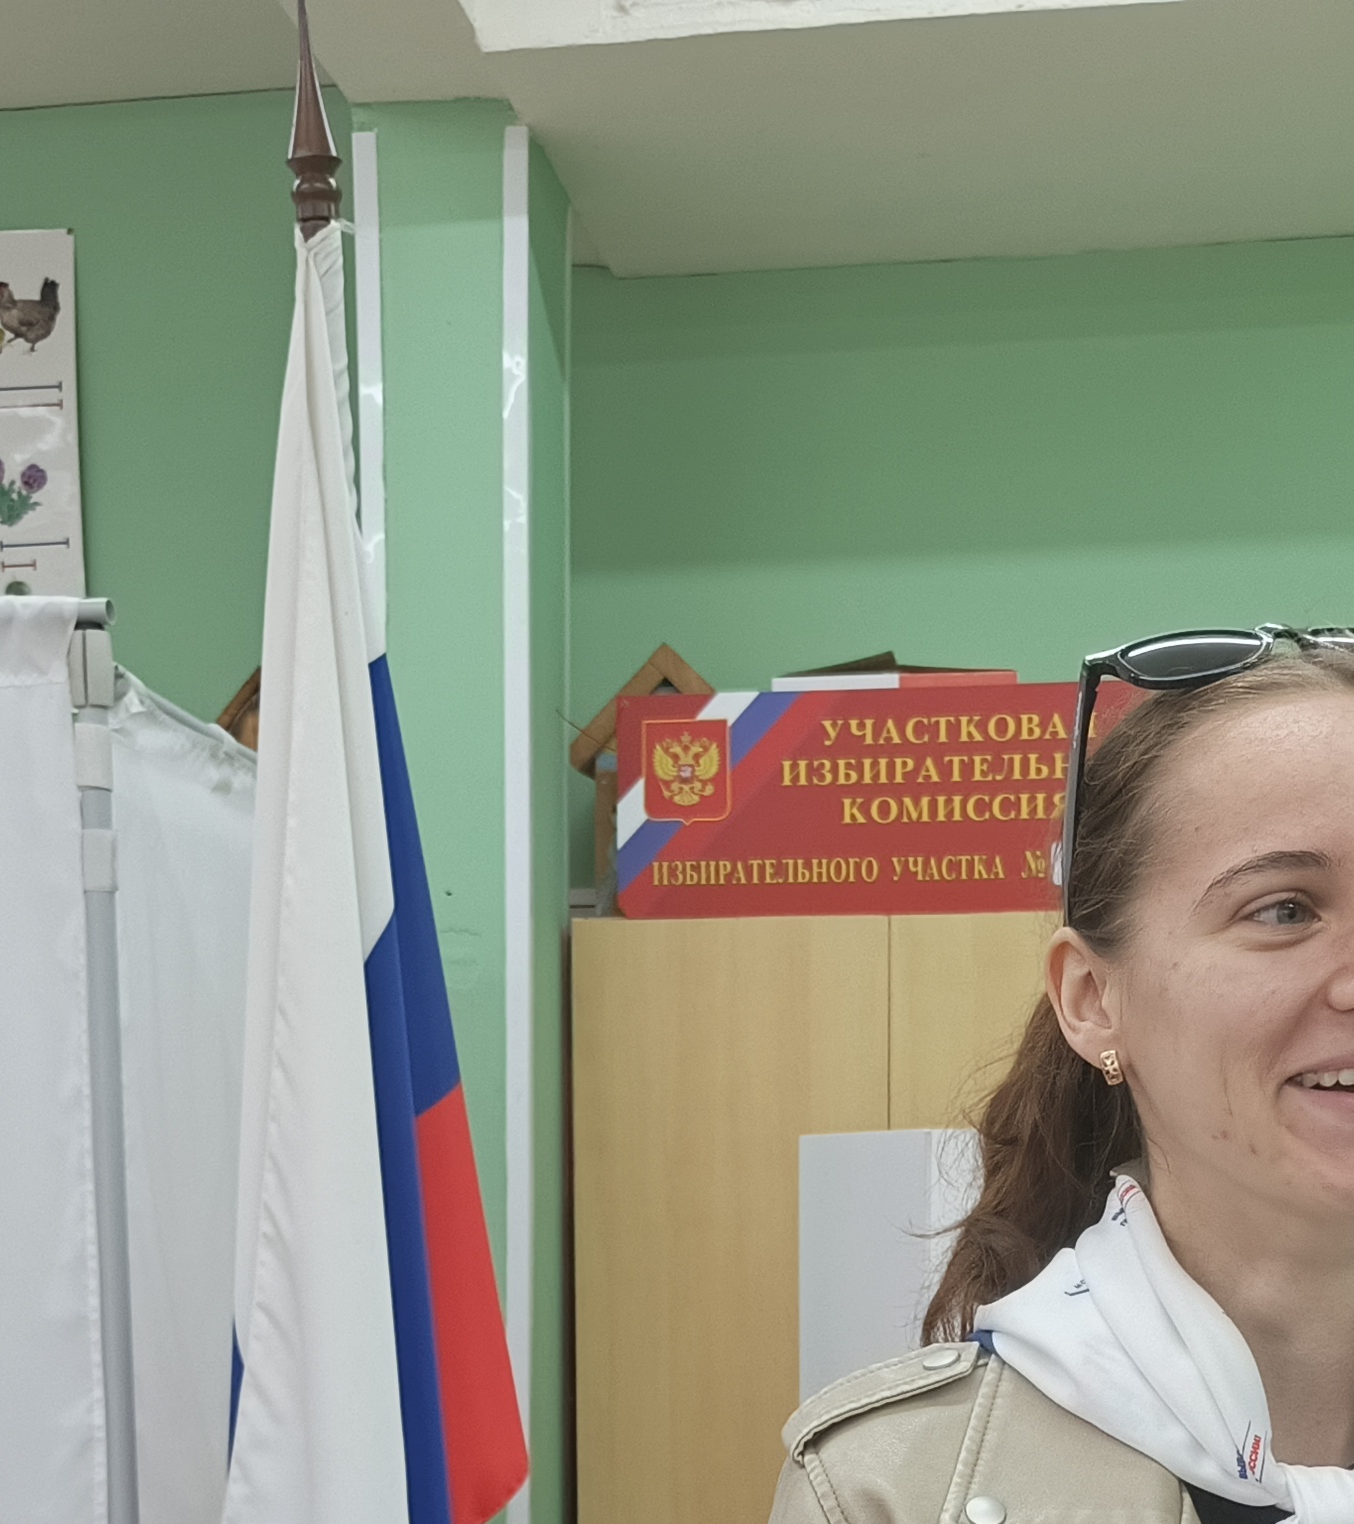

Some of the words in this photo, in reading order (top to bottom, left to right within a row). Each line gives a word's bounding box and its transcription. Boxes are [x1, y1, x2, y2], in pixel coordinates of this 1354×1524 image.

[780, 752, 1069, 787] ИЗБИРАТЕЛЬН
[652, 857, 879, 887] ИЗБИРАТЕЛЬНОГО
[892, 855, 1005, 881] УЧАСТКА
